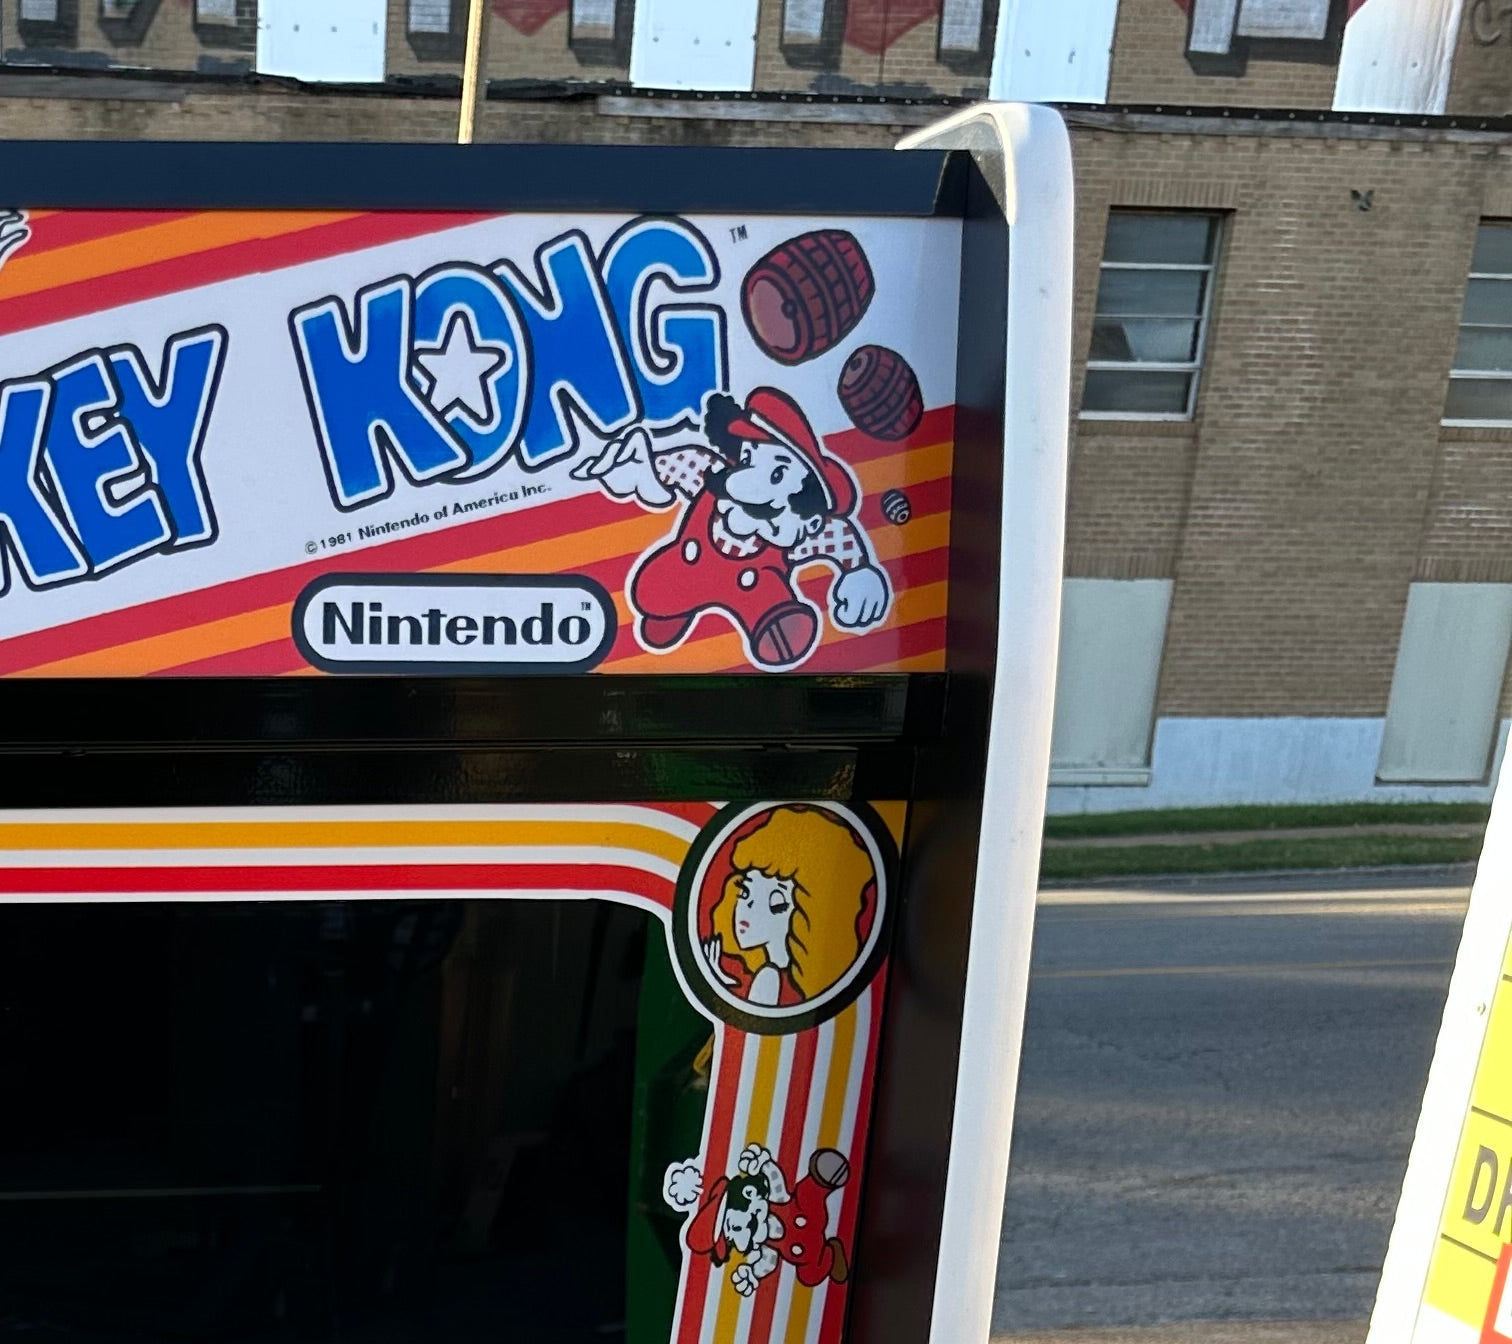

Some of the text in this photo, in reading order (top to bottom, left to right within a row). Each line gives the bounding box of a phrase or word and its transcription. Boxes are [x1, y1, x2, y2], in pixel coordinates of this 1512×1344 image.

[288, 213, 728, 512] KONG
[358, 513, 430, 541] Nintendo
[434, 506, 448, 520] of
[452, 490, 519, 515] America
[522, 483, 552, 498] Inc.
[321, 602, 588, 647] Nintendo
